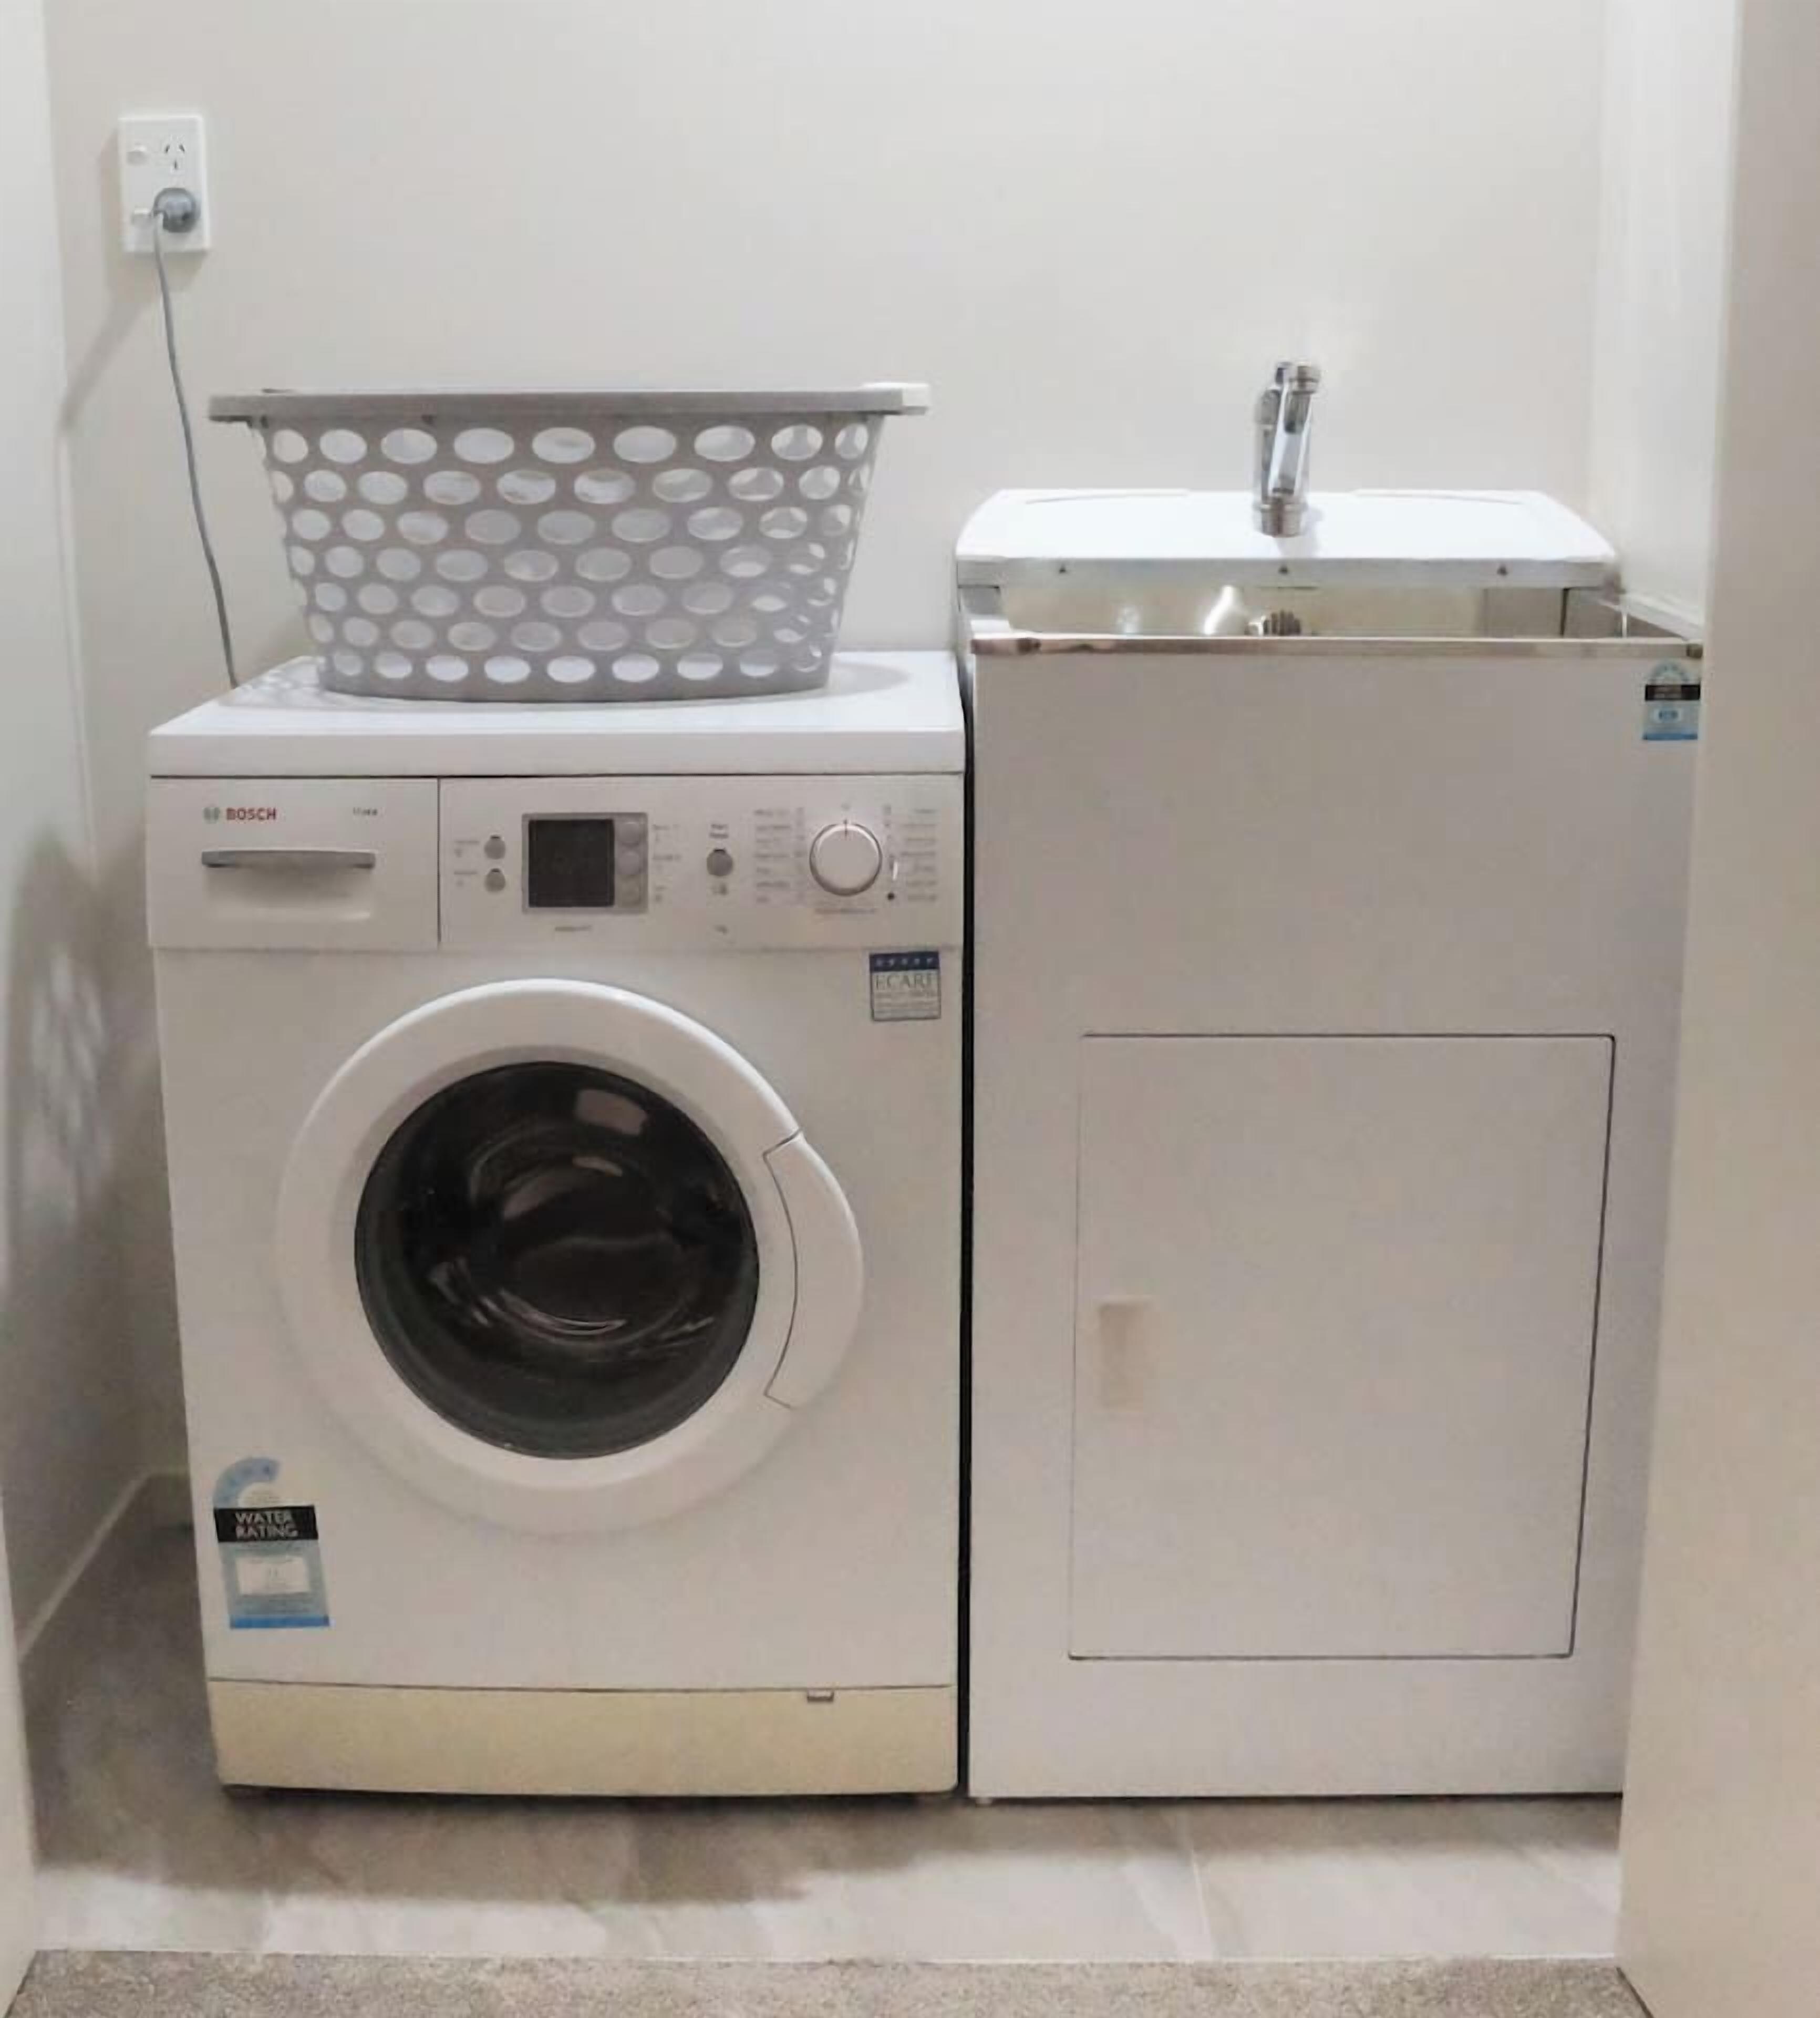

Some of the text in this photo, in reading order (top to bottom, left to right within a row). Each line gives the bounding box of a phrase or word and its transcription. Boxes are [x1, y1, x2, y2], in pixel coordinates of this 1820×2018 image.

[226, 807, 276, 820] BOSCH
[235, 1510, 293, 1525] WATER
[235, 1525, 298, 1539] RATING
